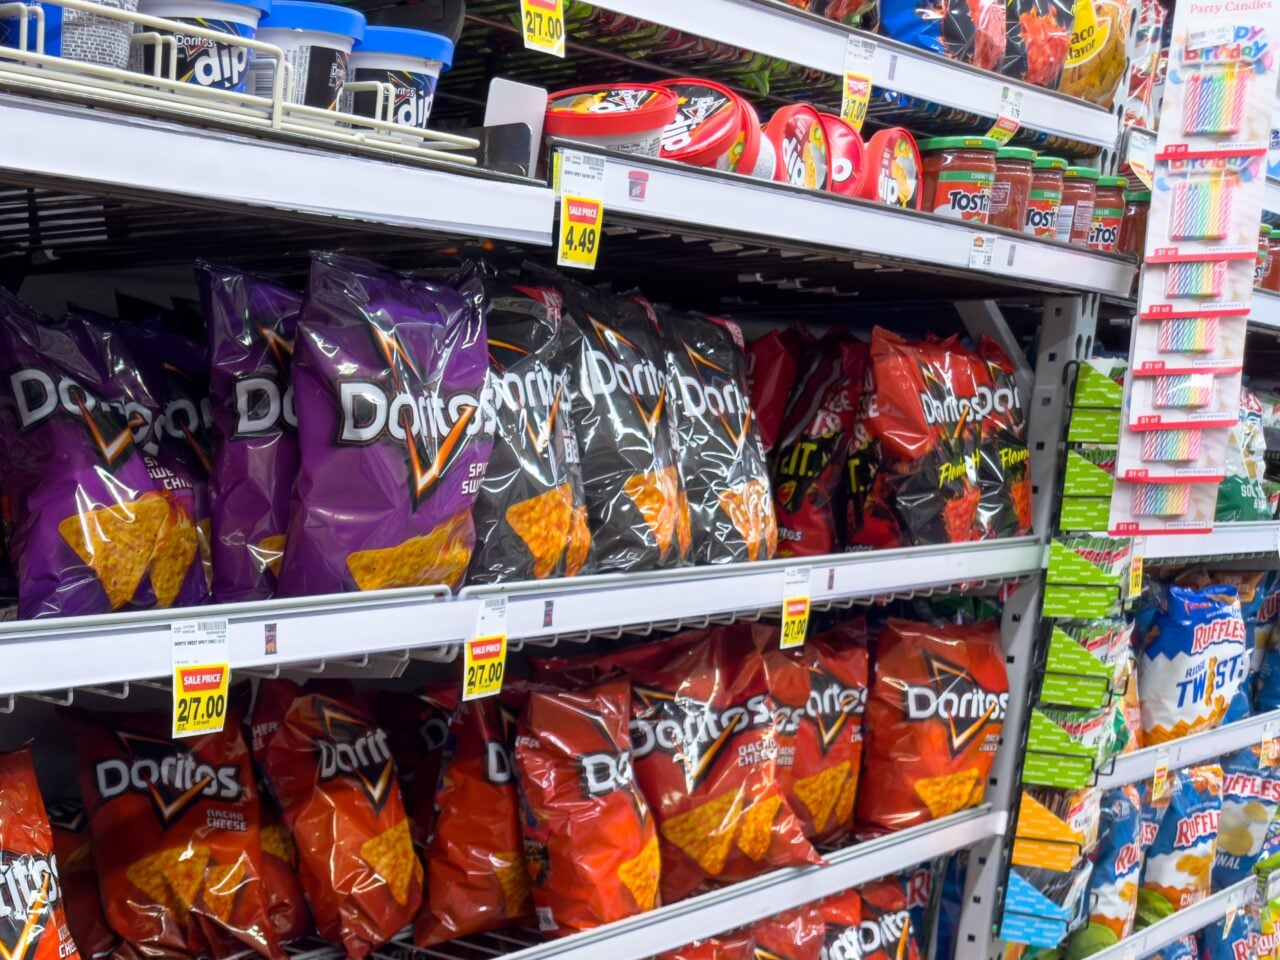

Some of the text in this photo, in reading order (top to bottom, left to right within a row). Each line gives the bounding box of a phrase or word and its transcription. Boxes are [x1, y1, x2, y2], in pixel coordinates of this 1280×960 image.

[1190, 2, 1221, 15] Party
[175, 33, 215, 48] Doritos
[525, 10, 563, 41] 2/7.00
[193, 41, 248, 88] dip
[569, 205, 584, 217] SALE
[565, 225, 596, 254] 4.49
[1192, 618, 1245, 653] RUFFLES
[183, 673, 222, 686] SALE PRICE
[467, 661, 503, 689] 2/7.00
[177, 694, 225, 724] 2/7.00
[320, 728, 391, 779] Dorit
[97, 752, 241, 798] Doritos
[1175, 810, 1221, 848] RUFFL
